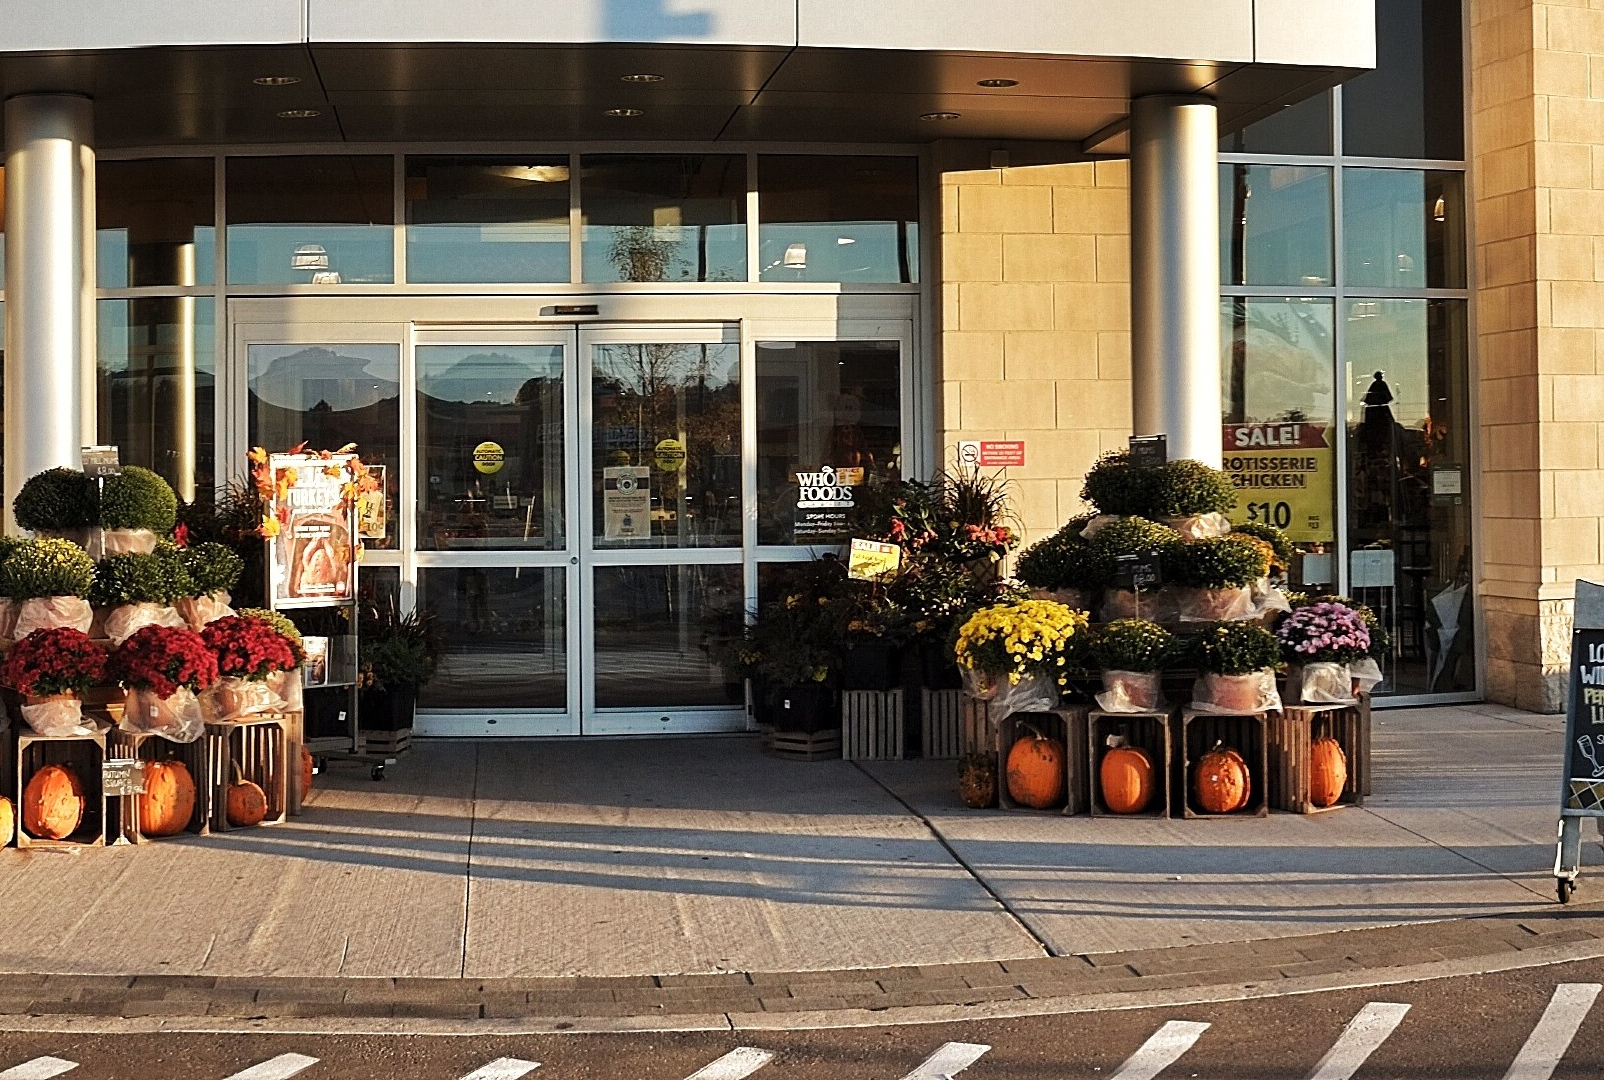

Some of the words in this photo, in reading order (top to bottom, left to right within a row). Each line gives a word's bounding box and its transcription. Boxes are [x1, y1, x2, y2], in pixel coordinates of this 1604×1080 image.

[1235, 425, 1300, 447] SALE!
[796, 466, 855, 486] WHOLE
[1231, 474, 1305, 488] CHICKEN
[799, 487, 853, 501] FOODS
[1247, 501, 1291, 529] $10
